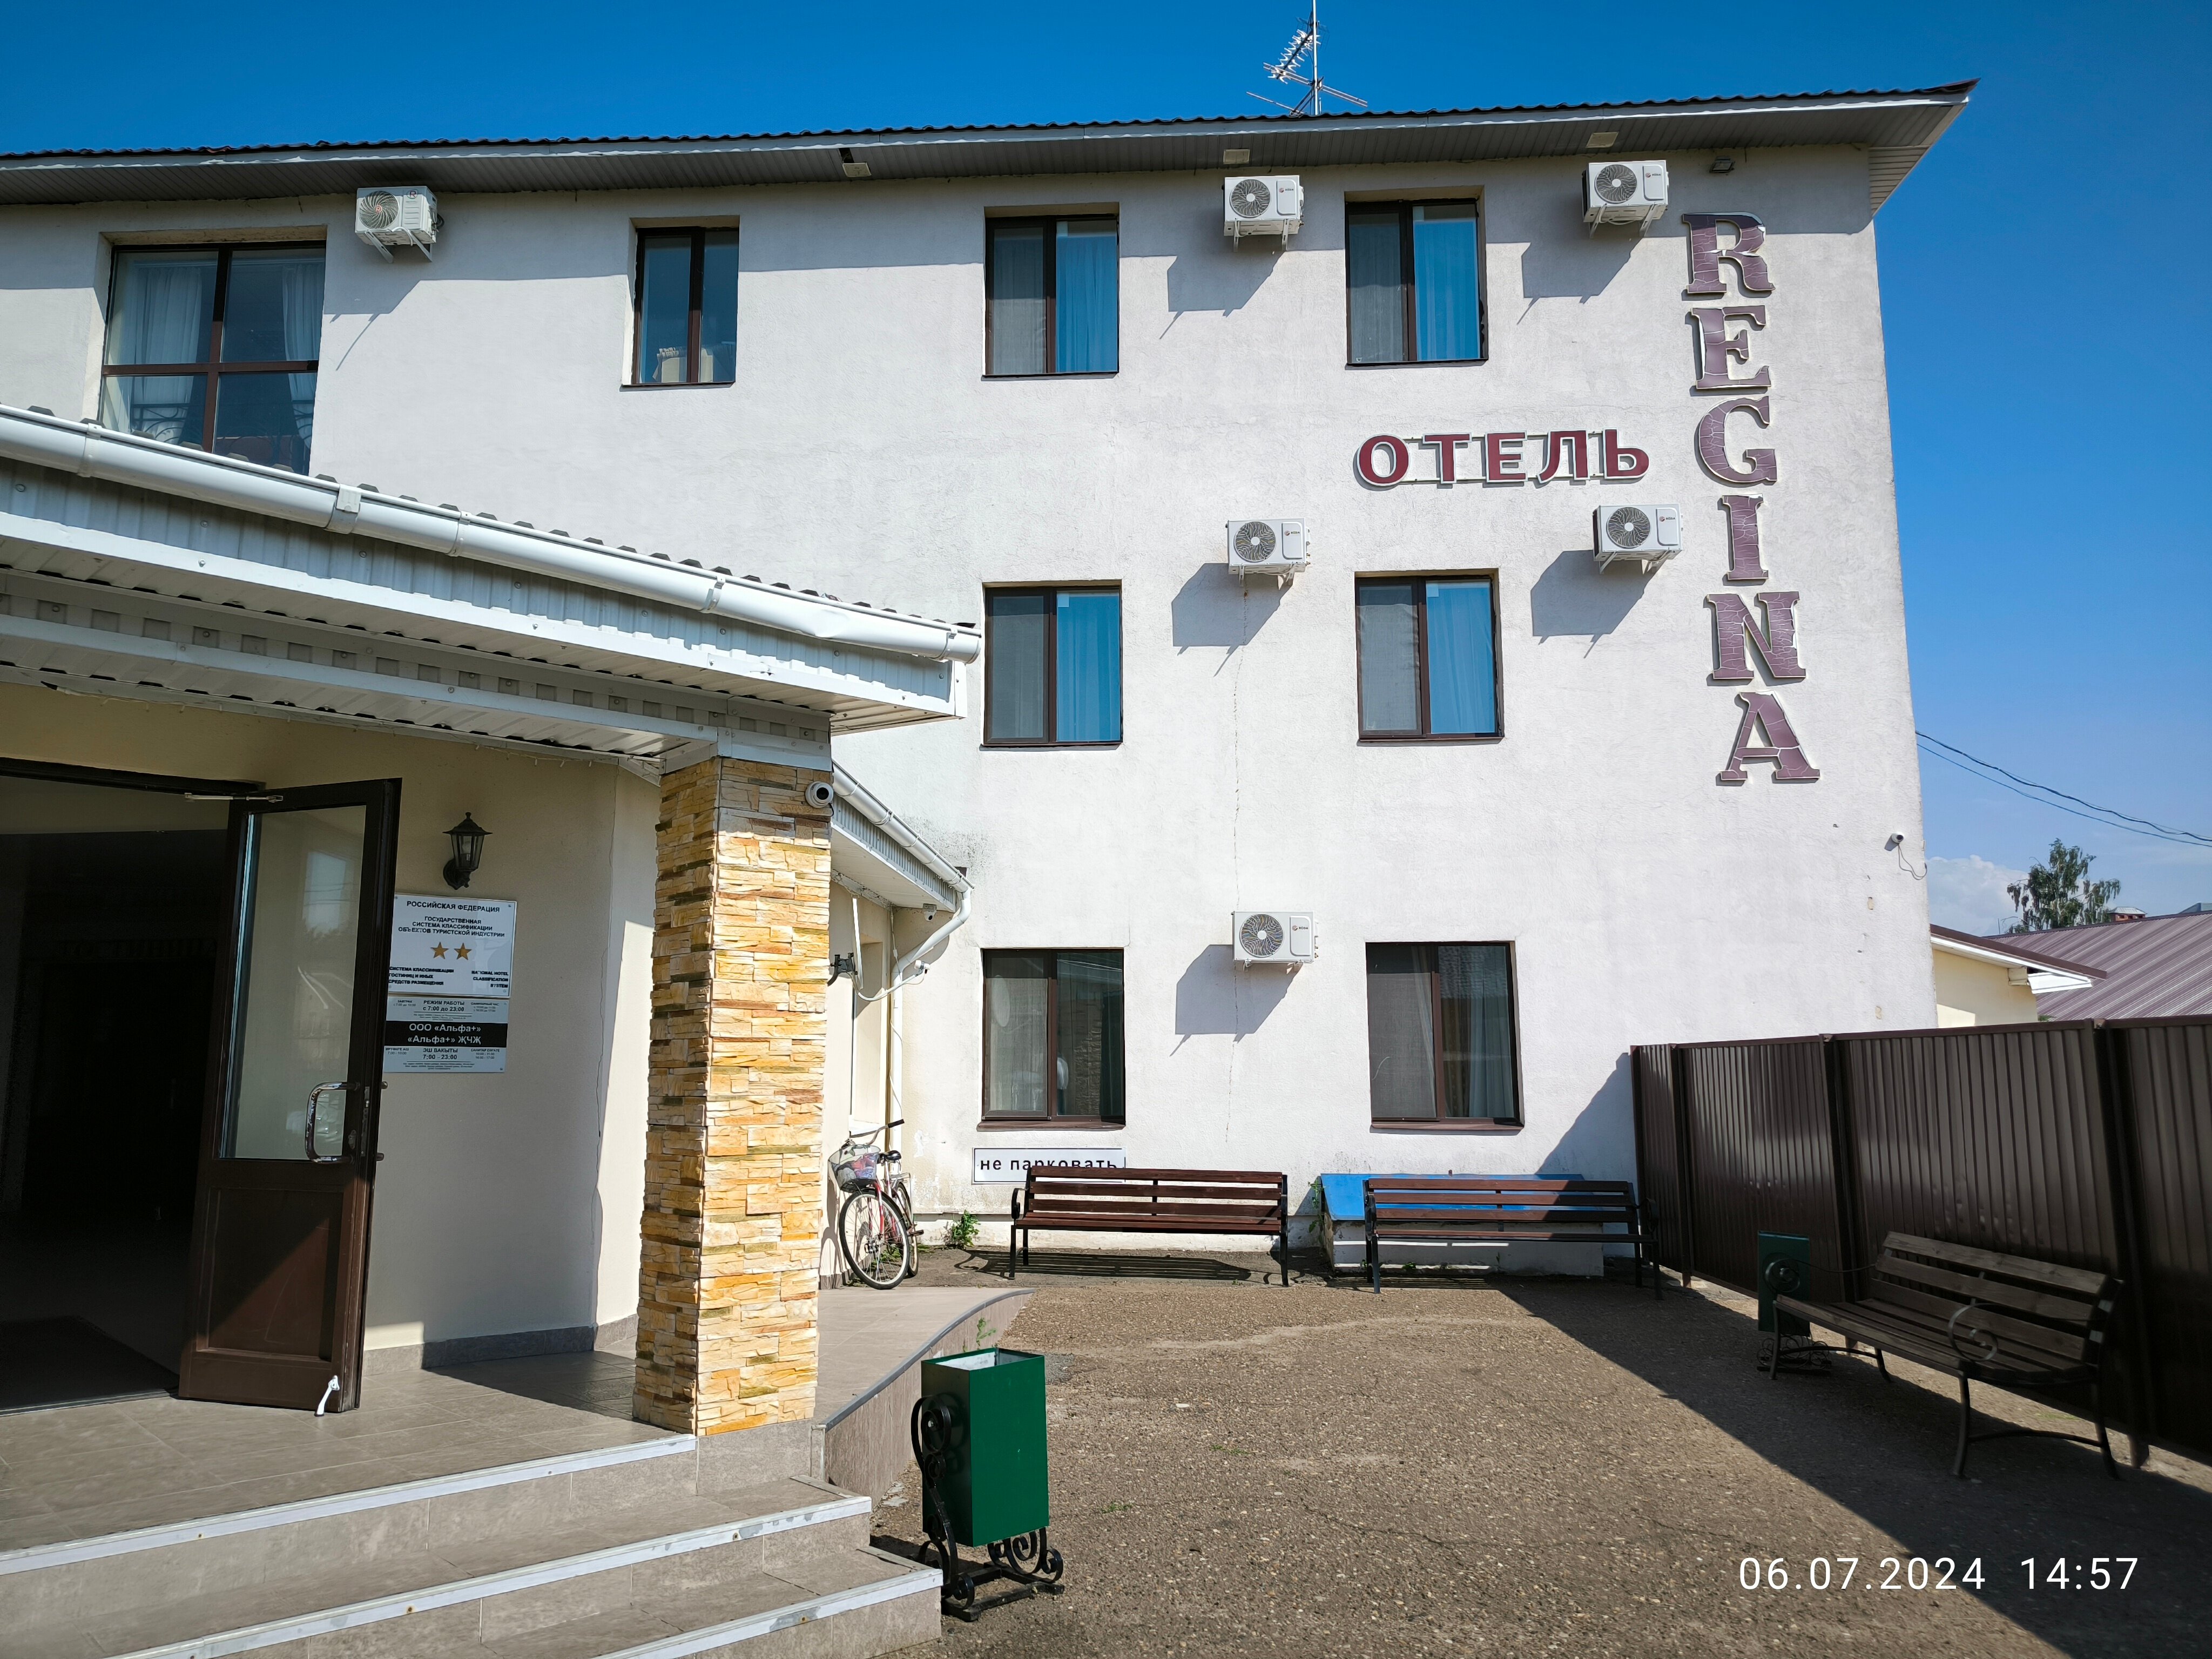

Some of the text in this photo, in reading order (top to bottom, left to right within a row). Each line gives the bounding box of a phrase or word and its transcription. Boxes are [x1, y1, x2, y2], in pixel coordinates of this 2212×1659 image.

[1355, 427, 1650, 486] ОТЕЛЬ
[1681, 211, 1821, 781] REGINA
[407, 901, 500, 913] РОССИЙСКАЯ ФЕДЕРАЦИЯ
[424, 916, 482, 924] ГОСУДАРСТВЕННАЯ
[442, 923, 493, 931] КЛАССИФИКАЦИИ
[409, 1023, 481, 1033] ООО «Альфа+»
[407, 1035, 456, 1044] «Альфа+»
[980, 1159, 1002, 1170] не
